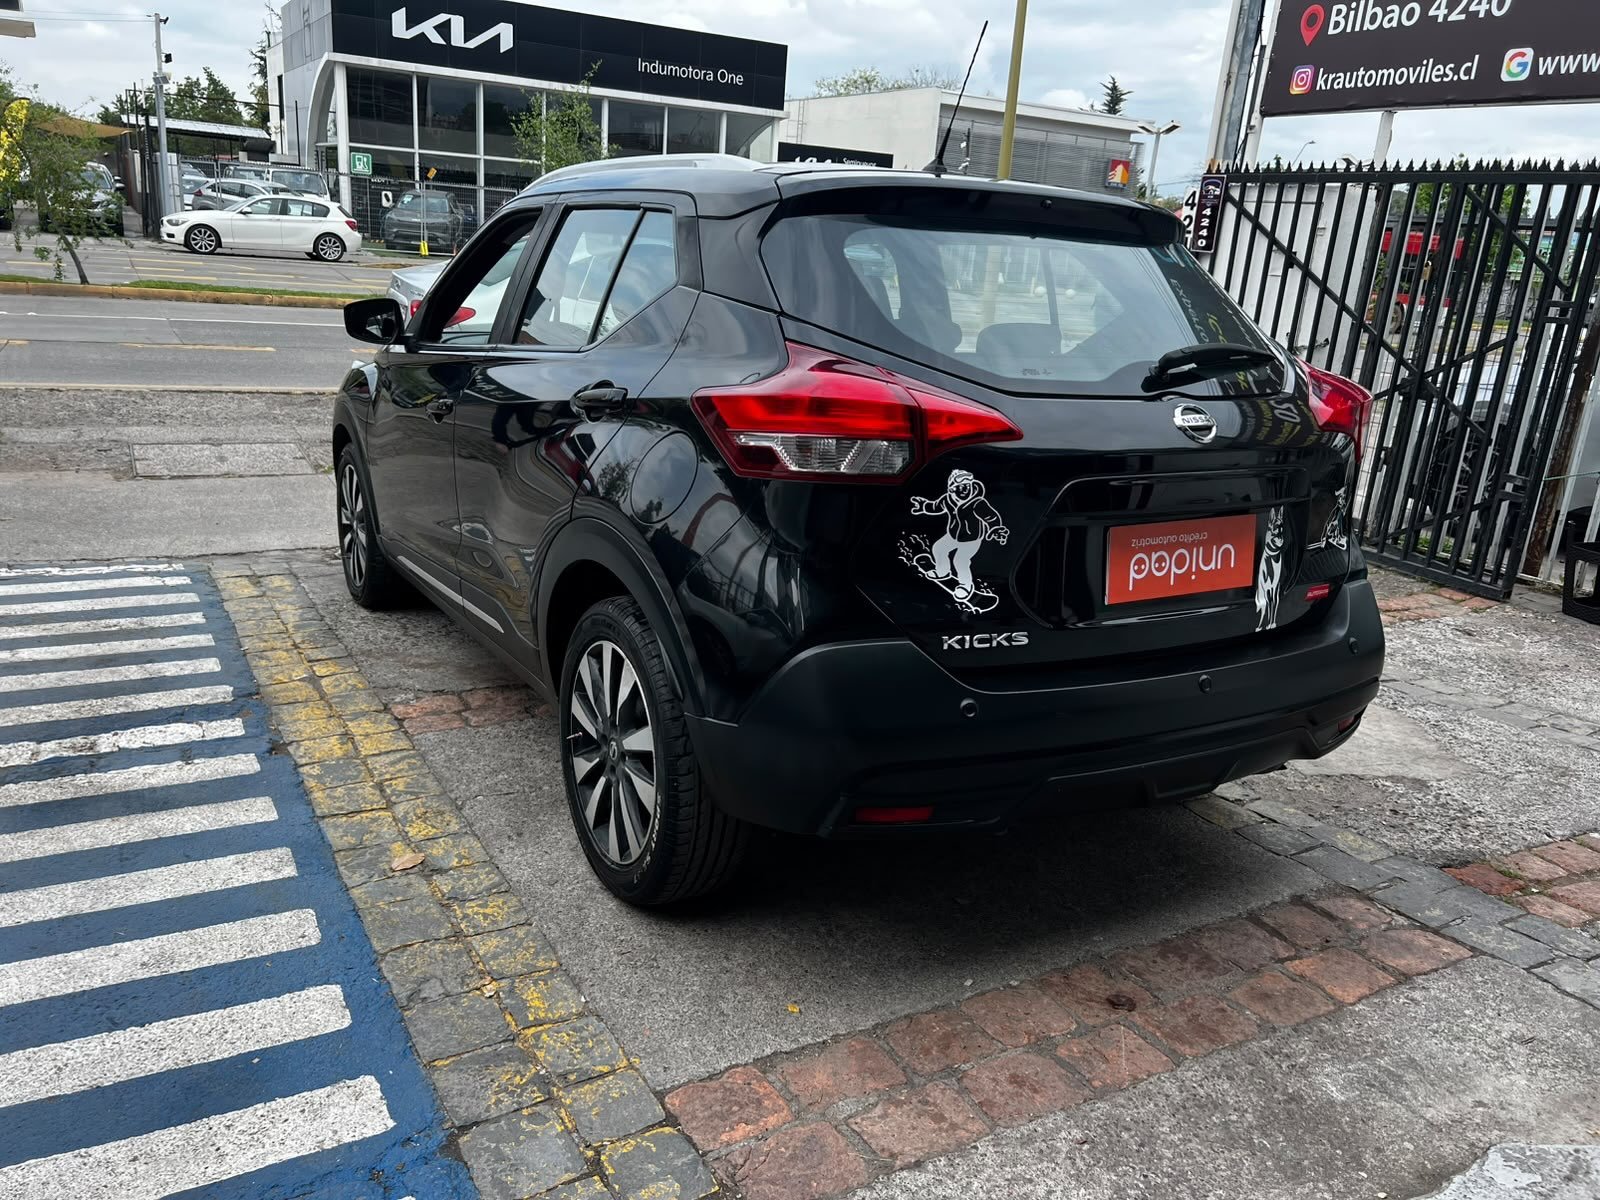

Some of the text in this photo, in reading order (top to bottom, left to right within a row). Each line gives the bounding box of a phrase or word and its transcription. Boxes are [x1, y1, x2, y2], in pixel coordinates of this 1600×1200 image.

[392, 7, 513, 53] KIA
[1327, 0, 1421, 35] Bilbao
[637, 57, 744, 86] Indumotora One
[1315, 54, 1480, 91] krautomoviles.cl
[1131, 531, 1208, 549] crédito automotriz
[1128, 543, 1236, 591] unidad
[941, 631, 1029, 650] KICKS
